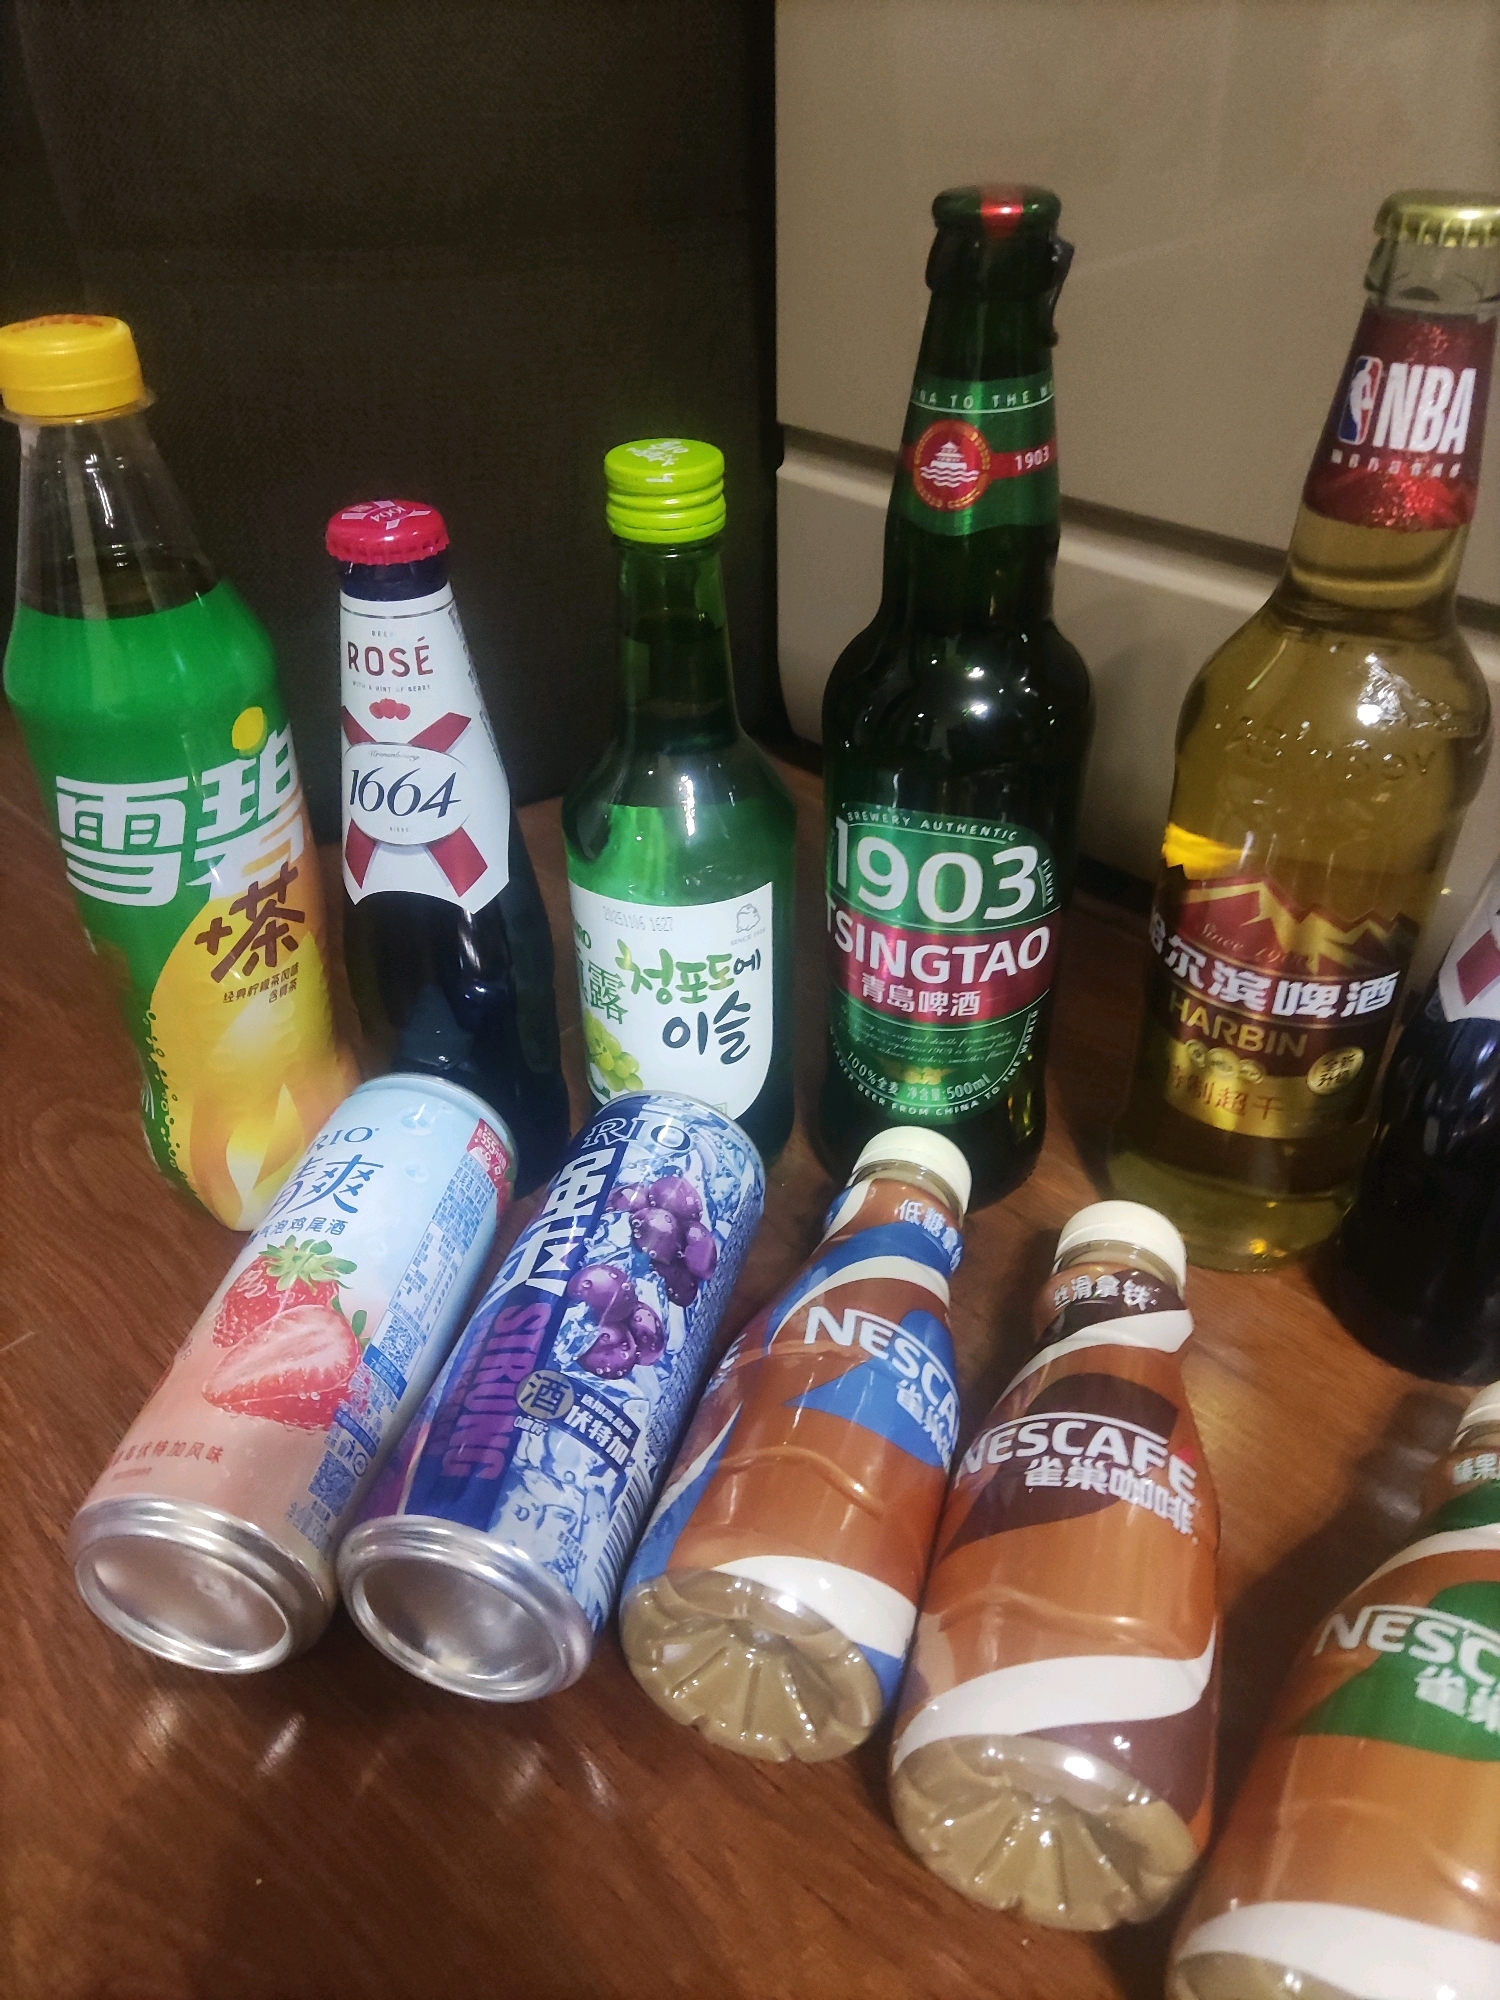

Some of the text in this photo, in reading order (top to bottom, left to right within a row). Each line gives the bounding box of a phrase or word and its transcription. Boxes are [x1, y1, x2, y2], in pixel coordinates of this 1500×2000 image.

[950, 393, 975, 410] TO
[992, 390, 1030, 408] THE
[1372, 362, 1477, 456] NBA
[1014, 445, 1050, 471] 1903
[347, 635, 434, 678] ROSÉ
[55, 722, 305, 907] 雪碧
[349, 766, 462, 819] 1664
[846, 810, 1018, 842] BREWERY AUTHENTIC
[835, 815, 1039, 924] 1903
[825, 891, 1050, 987] TSINGTAO
[614, 938, 762, 1005] 청포도에
[662, 990, 752, 1065] 이슬
[1170, 988, 1309, 1058] HARBIN
[857, 1083, 886, 1106] BEER
[891, 1102, 930, 1116] FROM
[935, 1099, 980, 1116] CHINA
[984, 1086, 1001, 1100] TO
[307, 1127, 373, 1155] RIO
[581, 1118, 691, 1151] RIO
[246, 1217, 349, 1248] 气泡鸡尾酒
[1053, 1274, 1151, 1312] 丝滑拿铁
[440, 1302, 551, 1480] STRONG
[521, 1373, 571, 1416] 酒
[804, 1305, 958, 1453] NESCA
[563, 1405, 630, 1466] 伏特加
[1024, 1456, 1194, 1535] 雀巢咖啡
